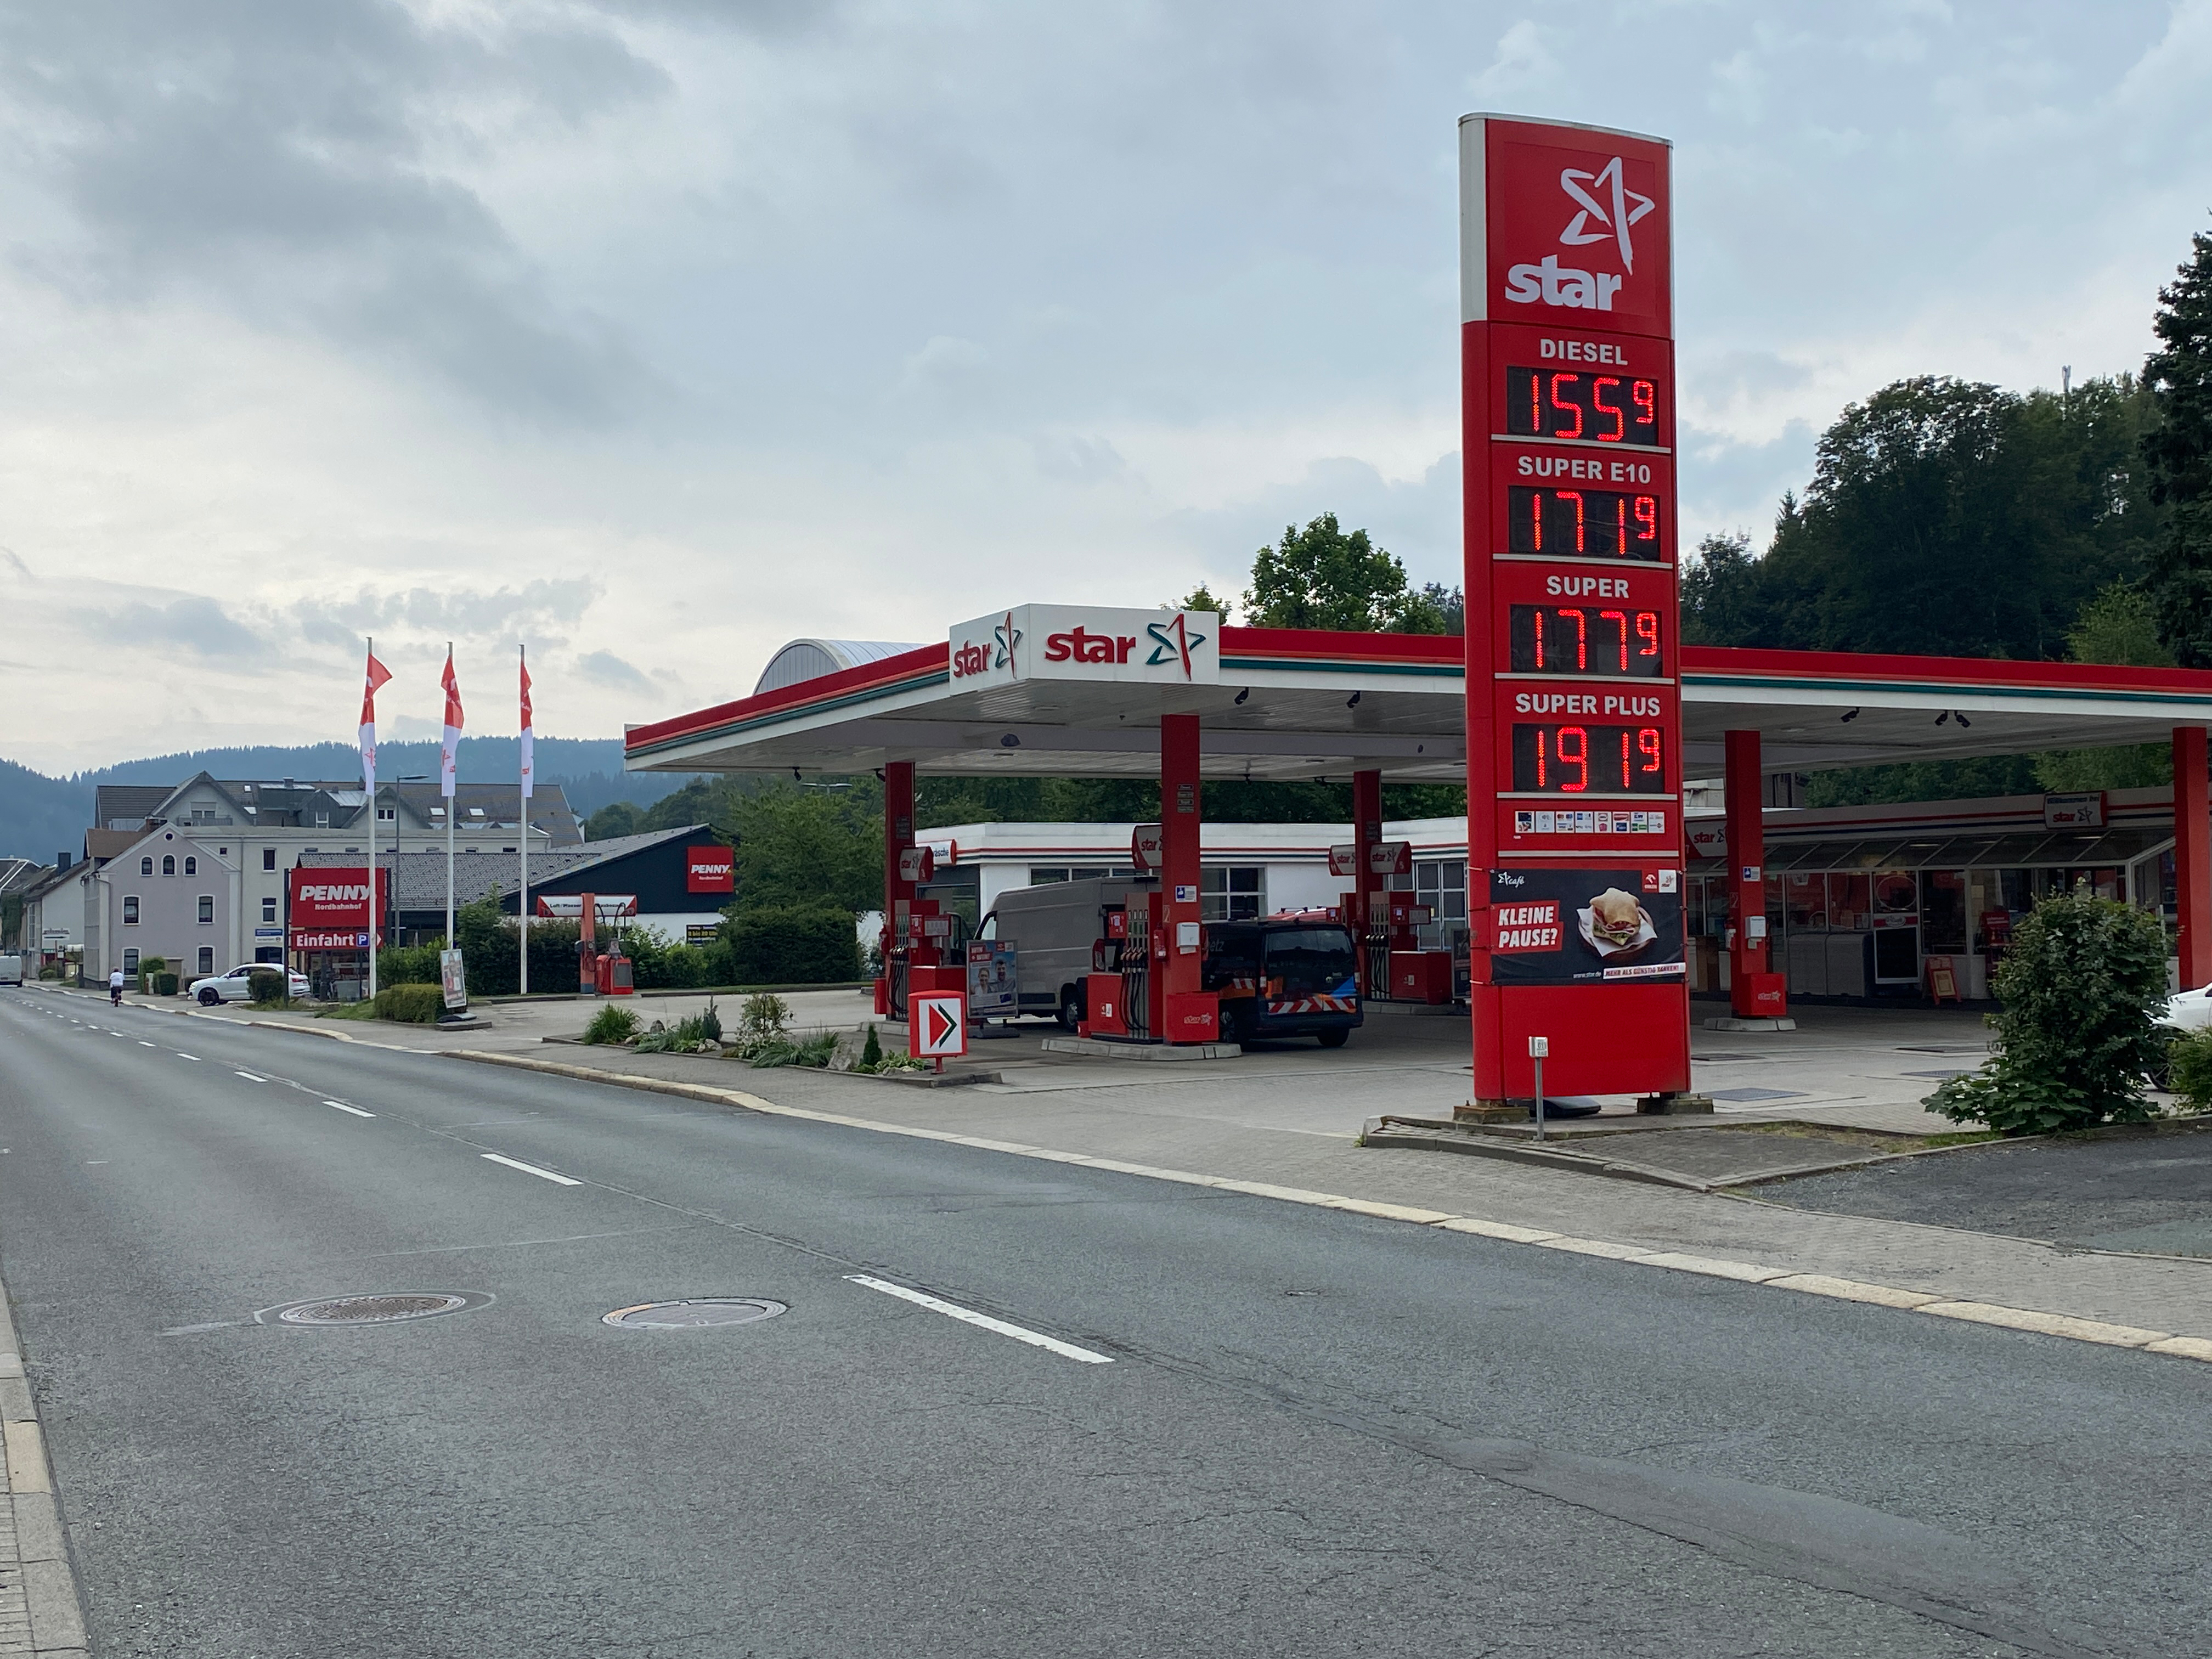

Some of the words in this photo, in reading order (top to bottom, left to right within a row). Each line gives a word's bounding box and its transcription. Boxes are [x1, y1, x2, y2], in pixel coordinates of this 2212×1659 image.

[1505, 255, 1622, 311] star
[1540, 338, 1628, 365] DIESEL
[1517, 456, 1603, 480] SUPER
[1610, 462, 1651, 484] E10
[1547, 575, 1629, 599] SUPER
[1045, 625, 1136, 664] star
[953, 639, 991, 678] star
[1515, 693, 1597, 714] SUPER
[1605, 696, 1661, 716] PLUS
[2053, 812, 2075, 822] star
[1141, 838, 1158, 851] star
[1694, 832, 1715, 843] star
[901, 859, 911, 868] star
[1337, 855, 1350, 864] star
[1372, 853, 1385, 862] star
[1498, 906, 1554, 926] KLEINE
[296, 933, 354, 947] Einfahrt
[1499, 928, 1558, 948] PAUSE?
